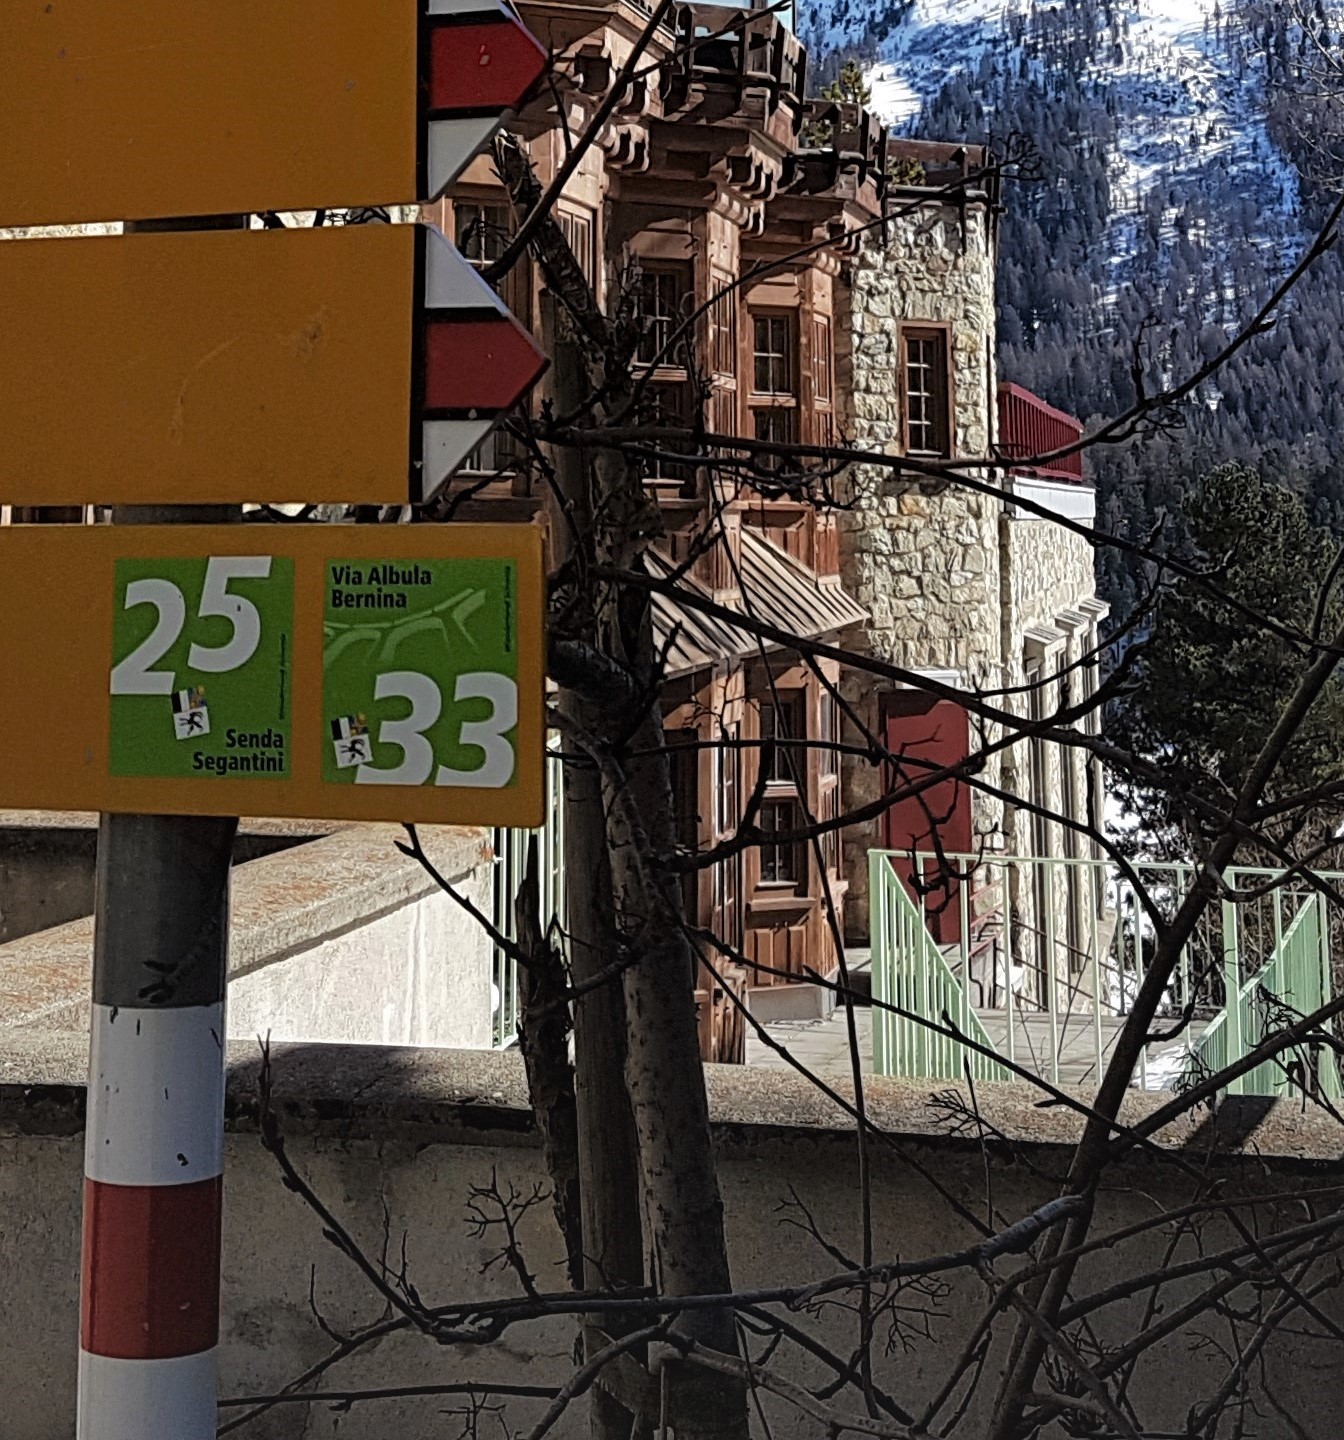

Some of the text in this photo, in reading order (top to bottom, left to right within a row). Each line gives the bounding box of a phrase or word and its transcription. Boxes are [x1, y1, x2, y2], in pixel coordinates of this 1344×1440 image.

[331, 564, 432, 586] Via Albula
[331, 588, 407, 609] Bernina
[110, 555, 272, 695] 25
[226, 728, 284, 748] Senda
[354, 671, 518, 788] 33
[192, 751, 284, 775] Segantini
